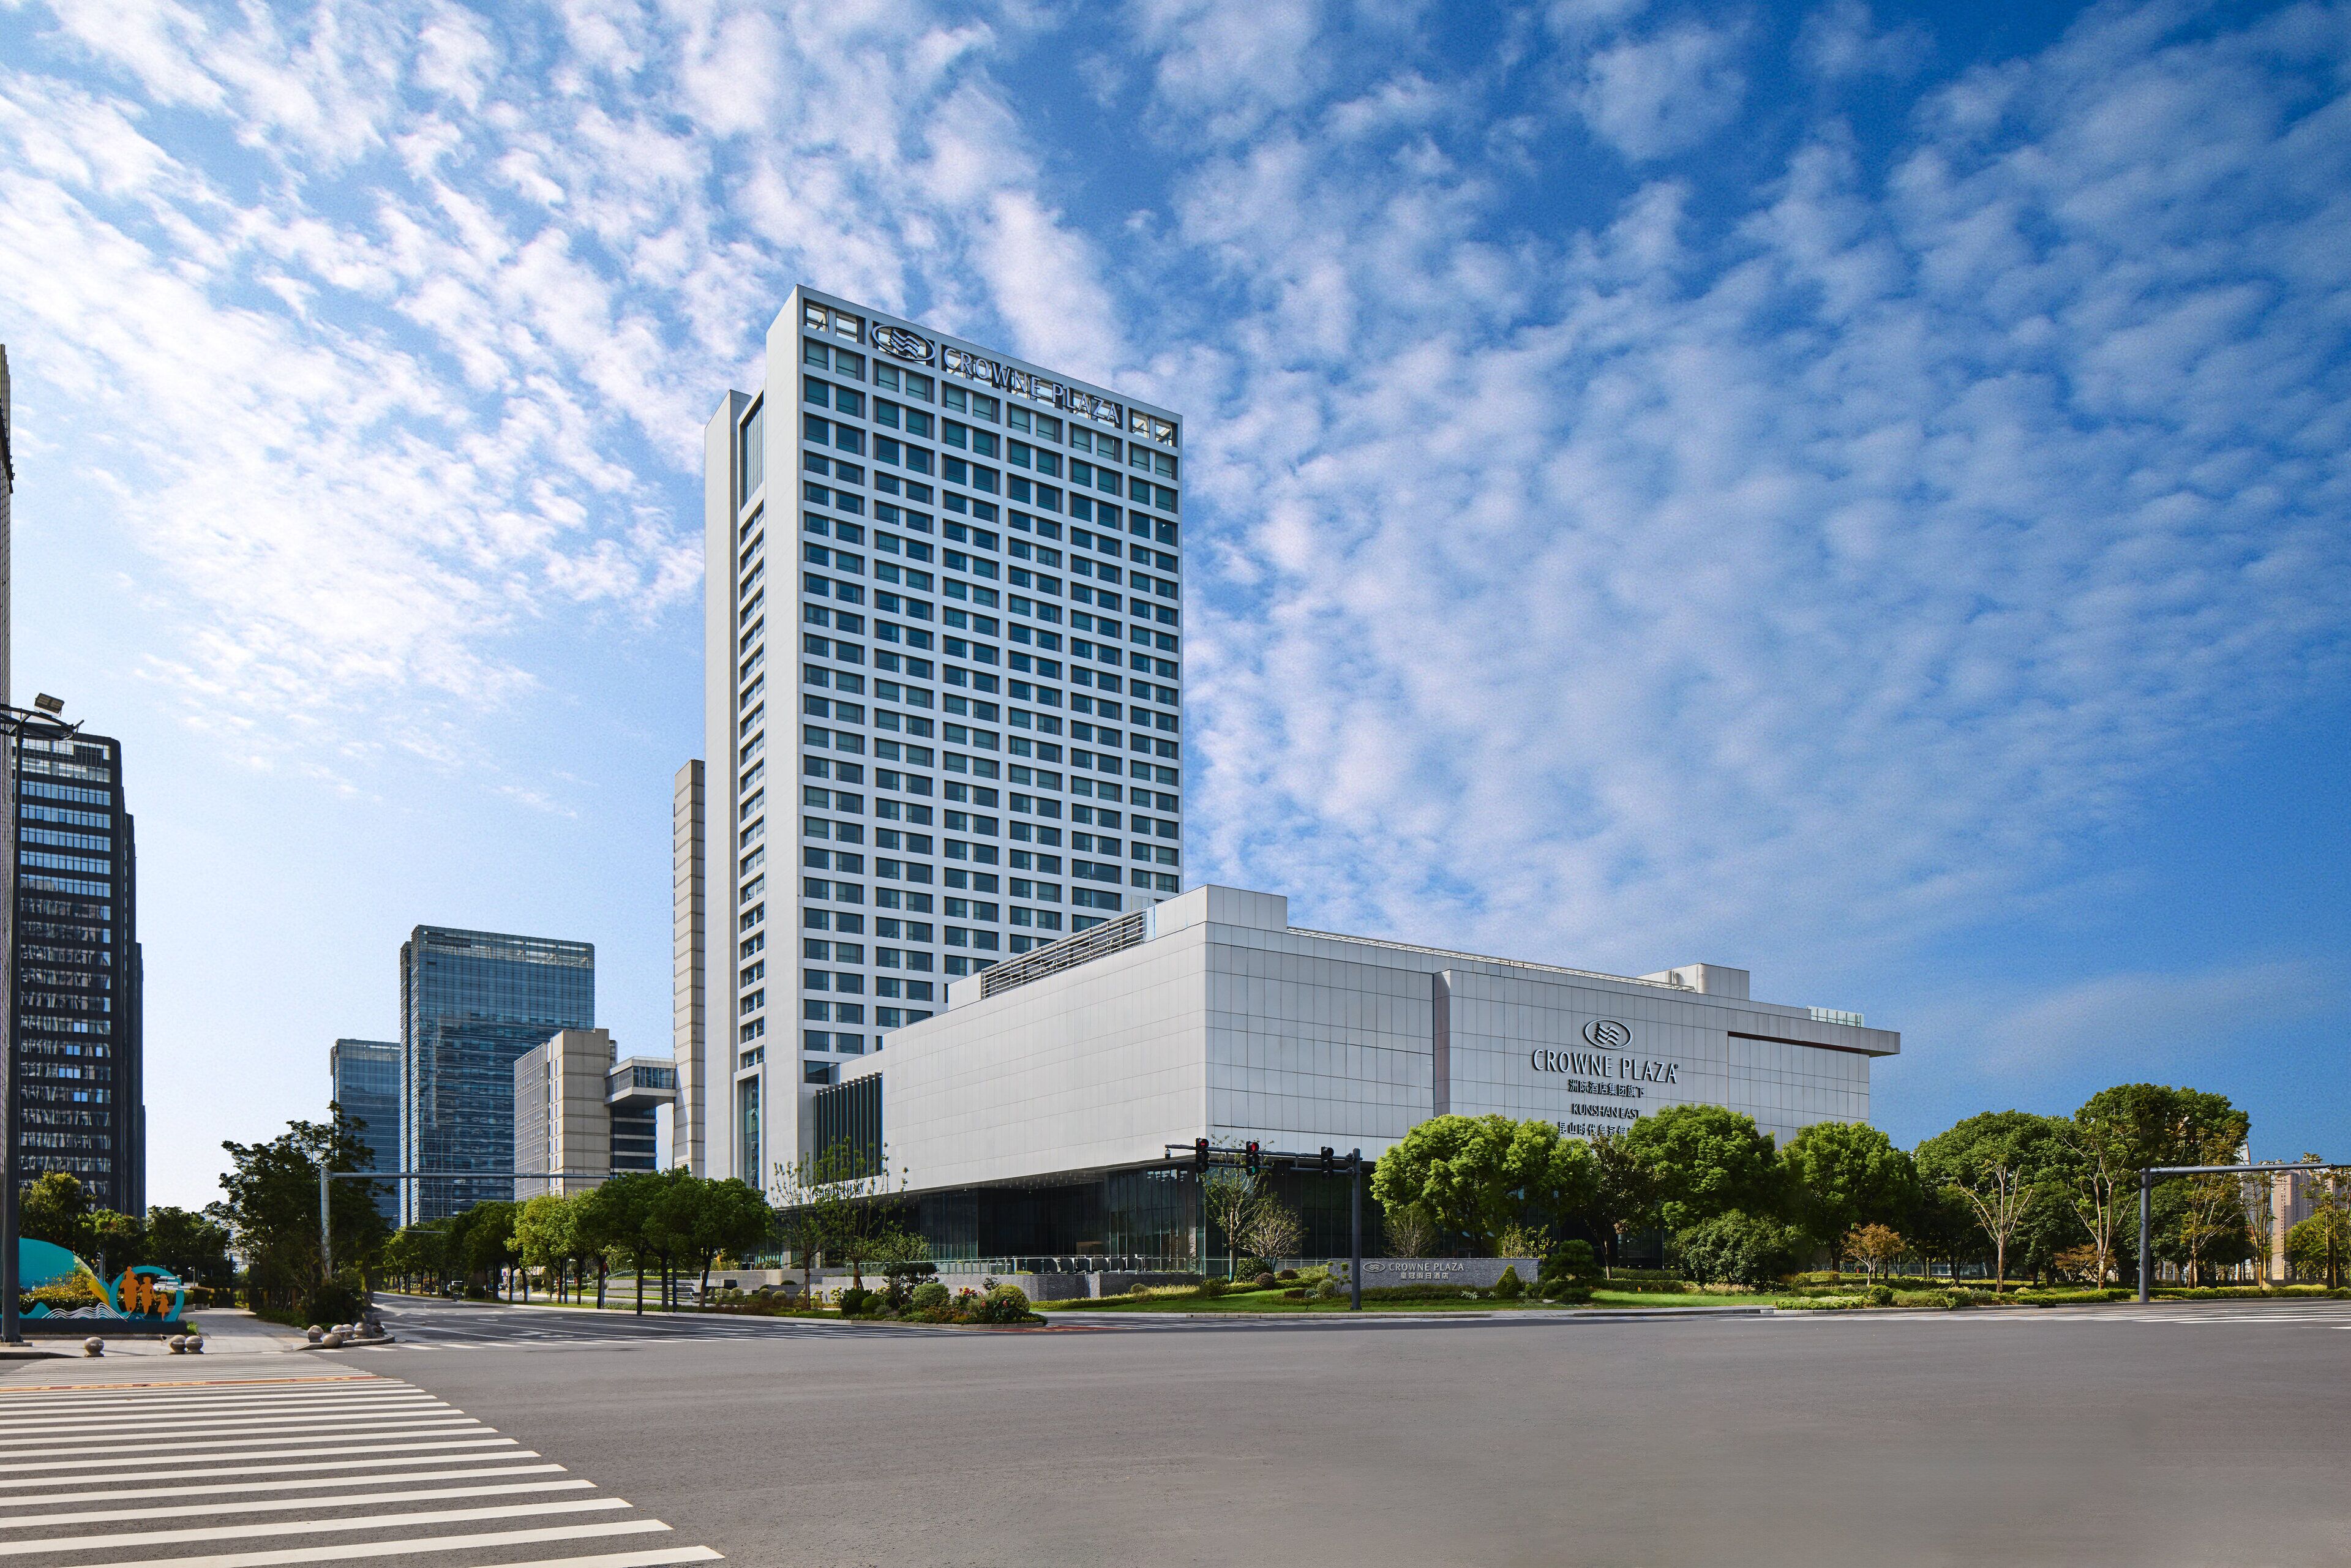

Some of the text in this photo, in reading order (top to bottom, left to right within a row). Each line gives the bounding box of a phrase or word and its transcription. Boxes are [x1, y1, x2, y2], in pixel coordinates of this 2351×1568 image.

[943, 348, 1041, 397] CROWNE
[1533, 1049, 1613, 1077] CROWNE
[1569, 1079, 1645, 1098] 洲际酒店集团旗下
[1572, 1103, 1641, 1119] KUNSHAN EAST
[1558, 1122, 1632, 1136] 昆山时代皇冠假
[1389, 1262, 1464, 1272] CROWNE PLAZA
